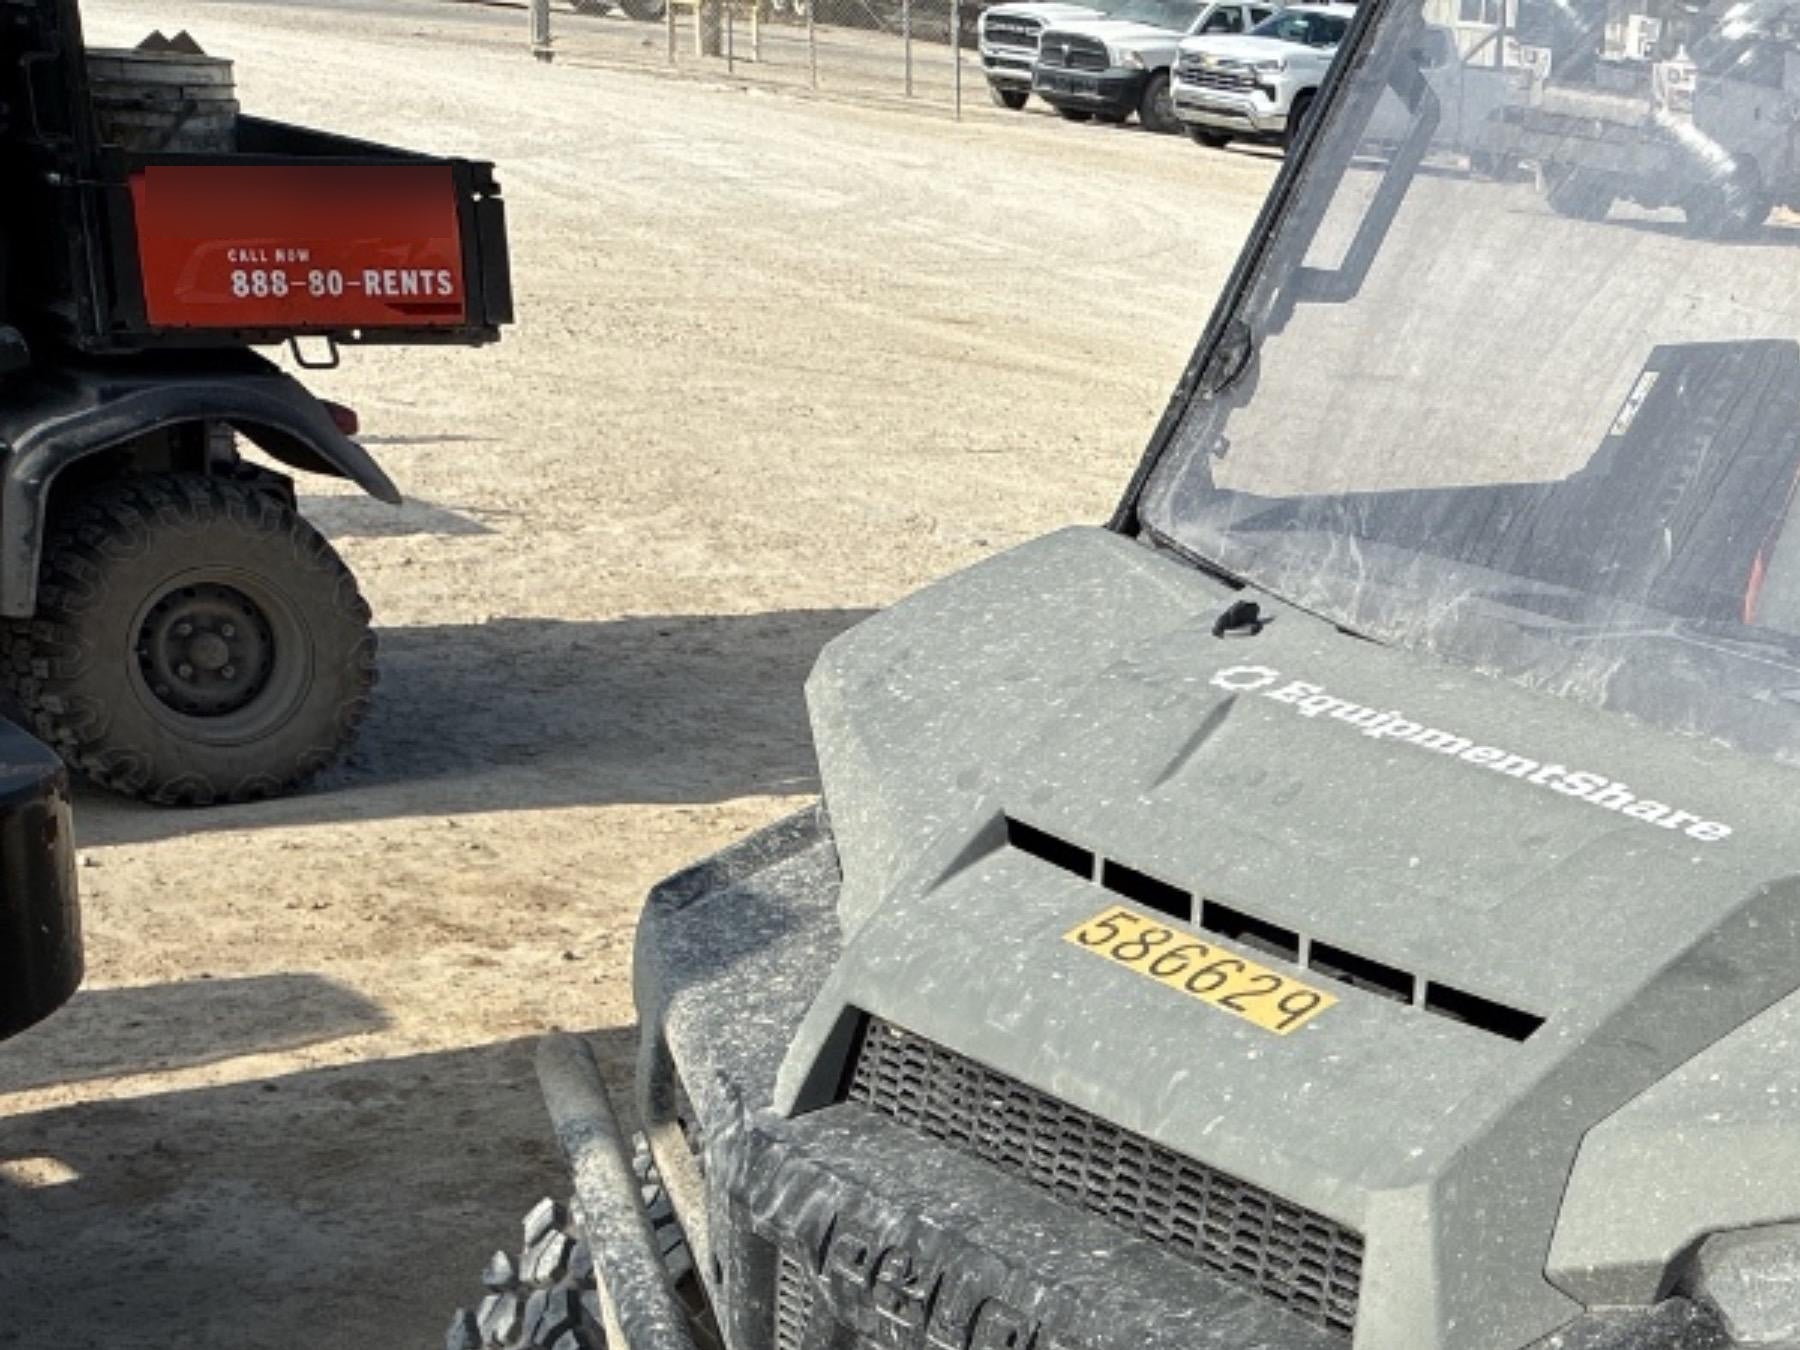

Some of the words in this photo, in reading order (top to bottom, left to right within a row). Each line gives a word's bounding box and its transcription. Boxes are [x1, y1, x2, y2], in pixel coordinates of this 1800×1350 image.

[227, 249, 268, 262] CALL
[230, 269, 454, 297] 888-80-RENTS
[1267, 680, 1733, 842] EquipmentShare
[1076, 910, 1322, 1031] 586629
